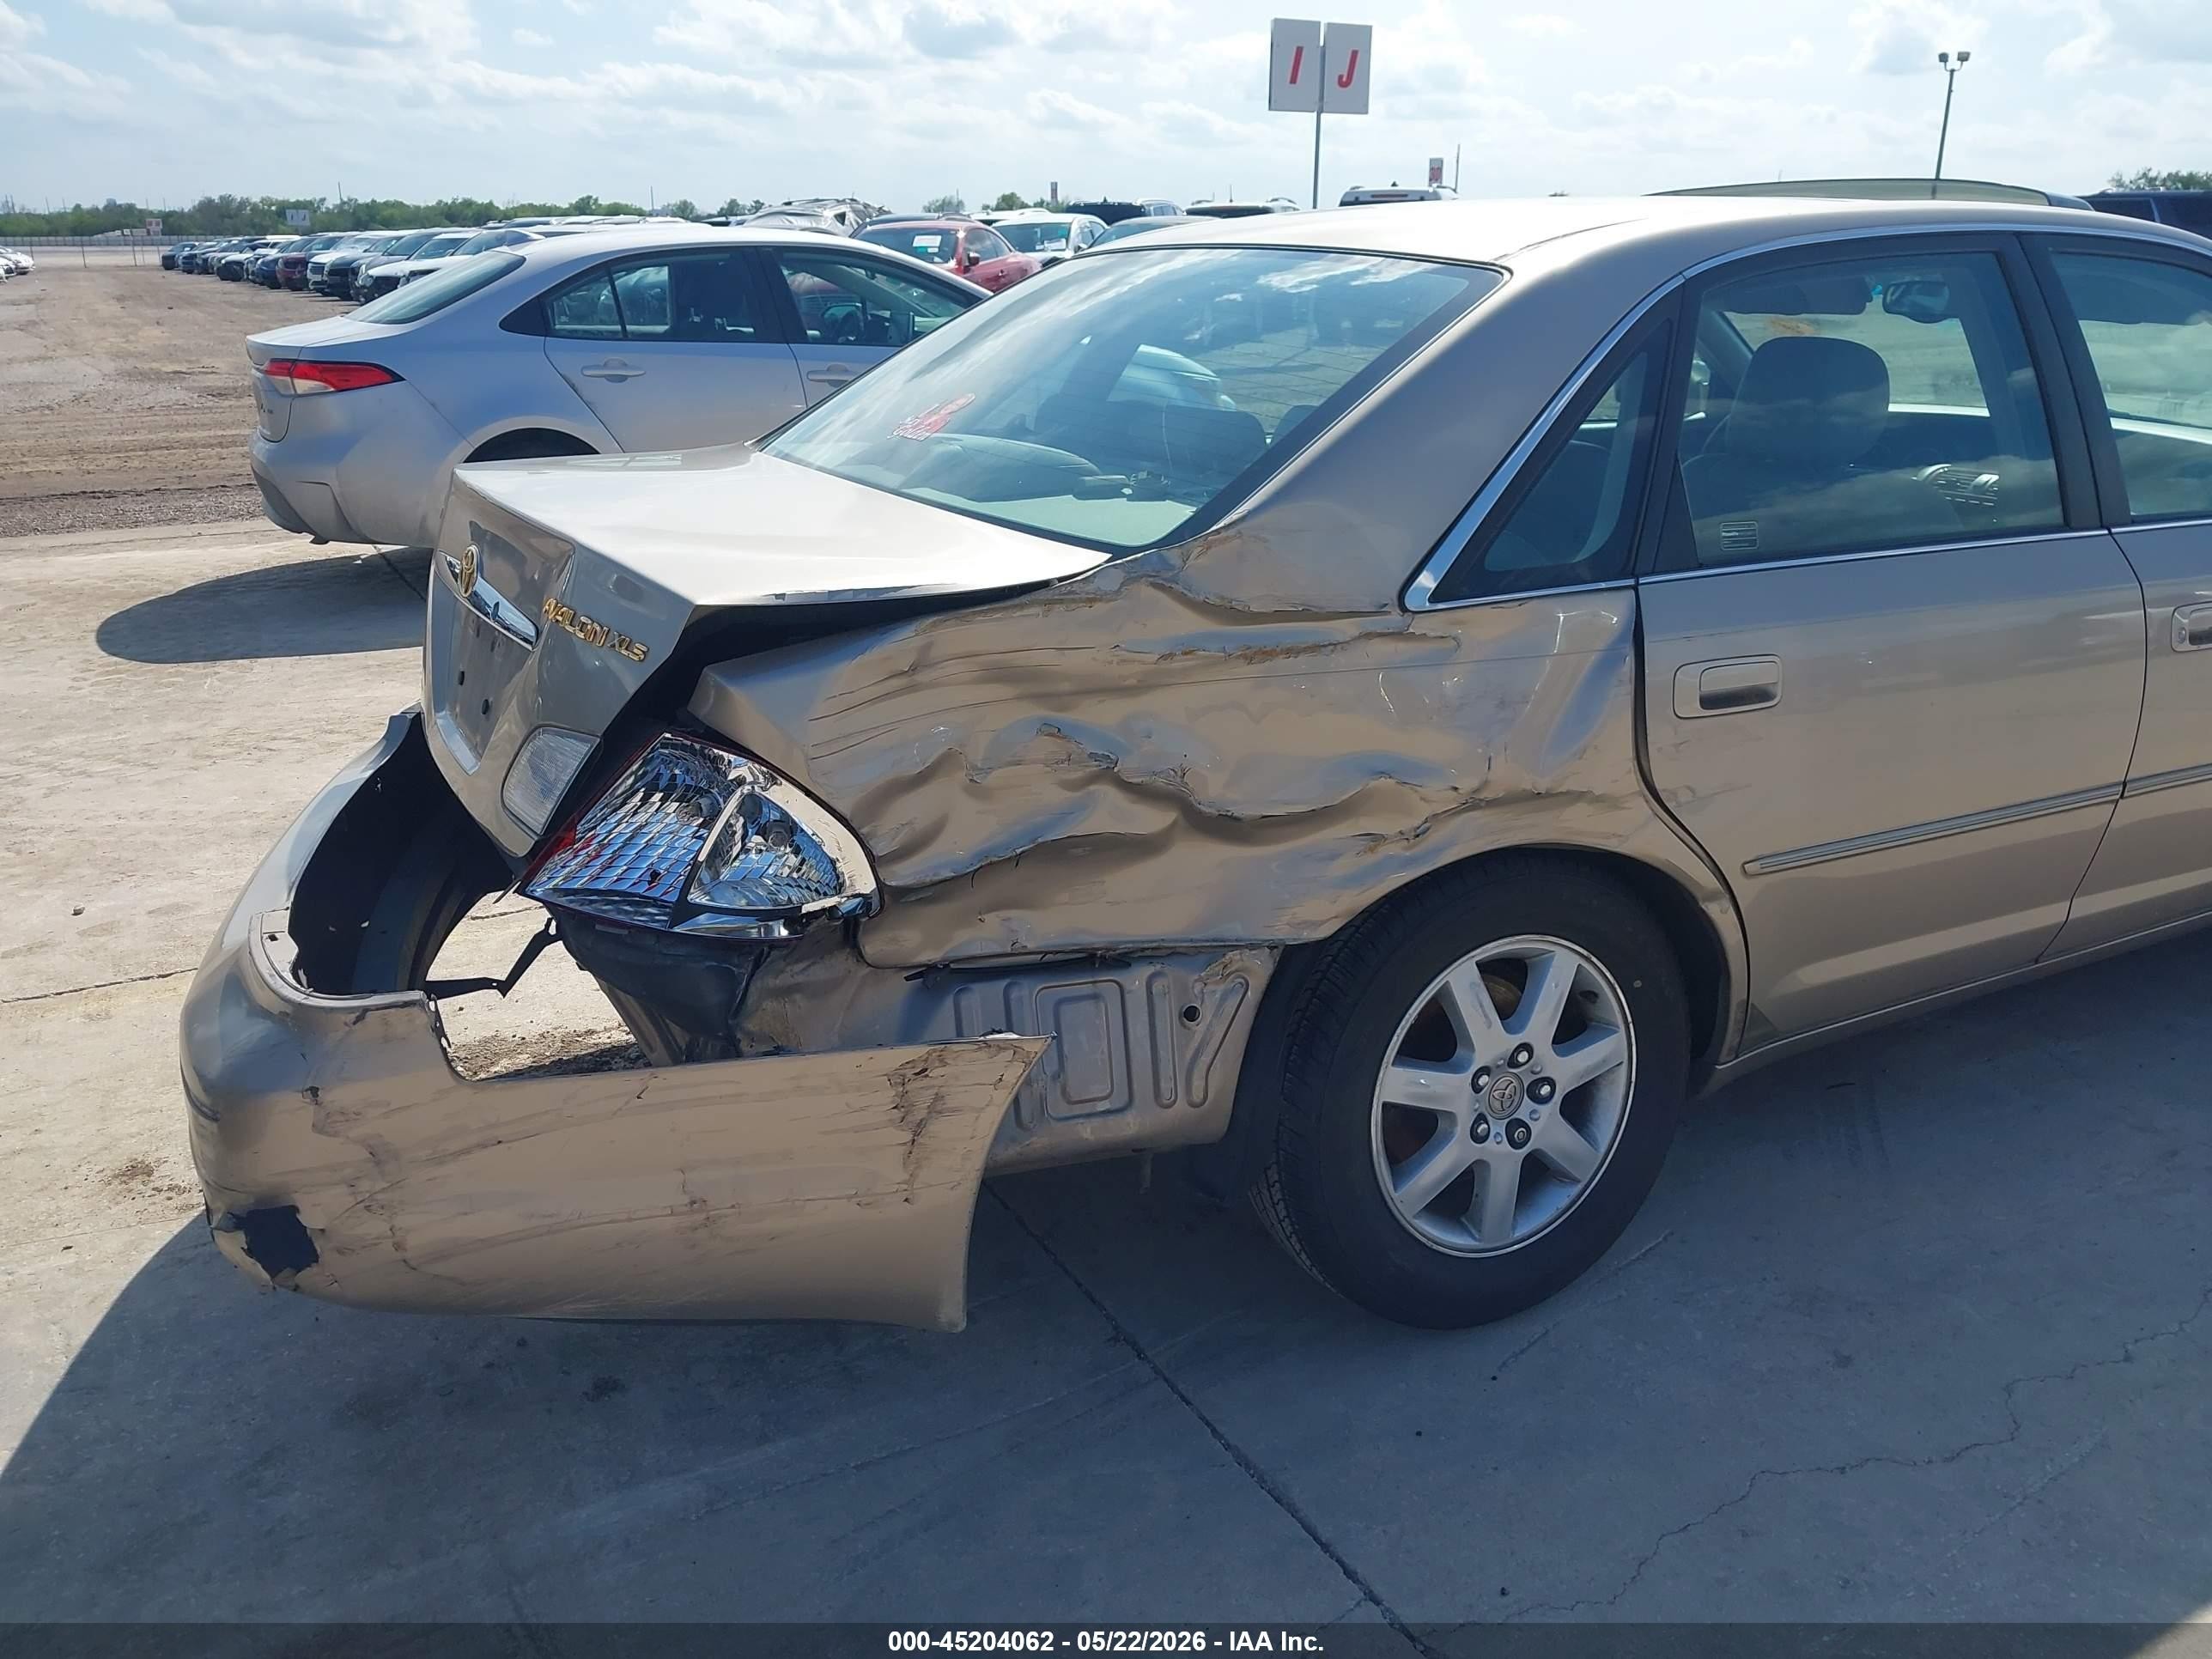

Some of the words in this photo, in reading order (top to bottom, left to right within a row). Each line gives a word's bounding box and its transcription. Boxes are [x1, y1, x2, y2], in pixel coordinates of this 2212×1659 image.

[1289, 46, 1304, 85] I
[1338, 49, 1359, 88] J
[543, 598, 610, 647] AVALON
[607, 631, 649, 661] XLS
